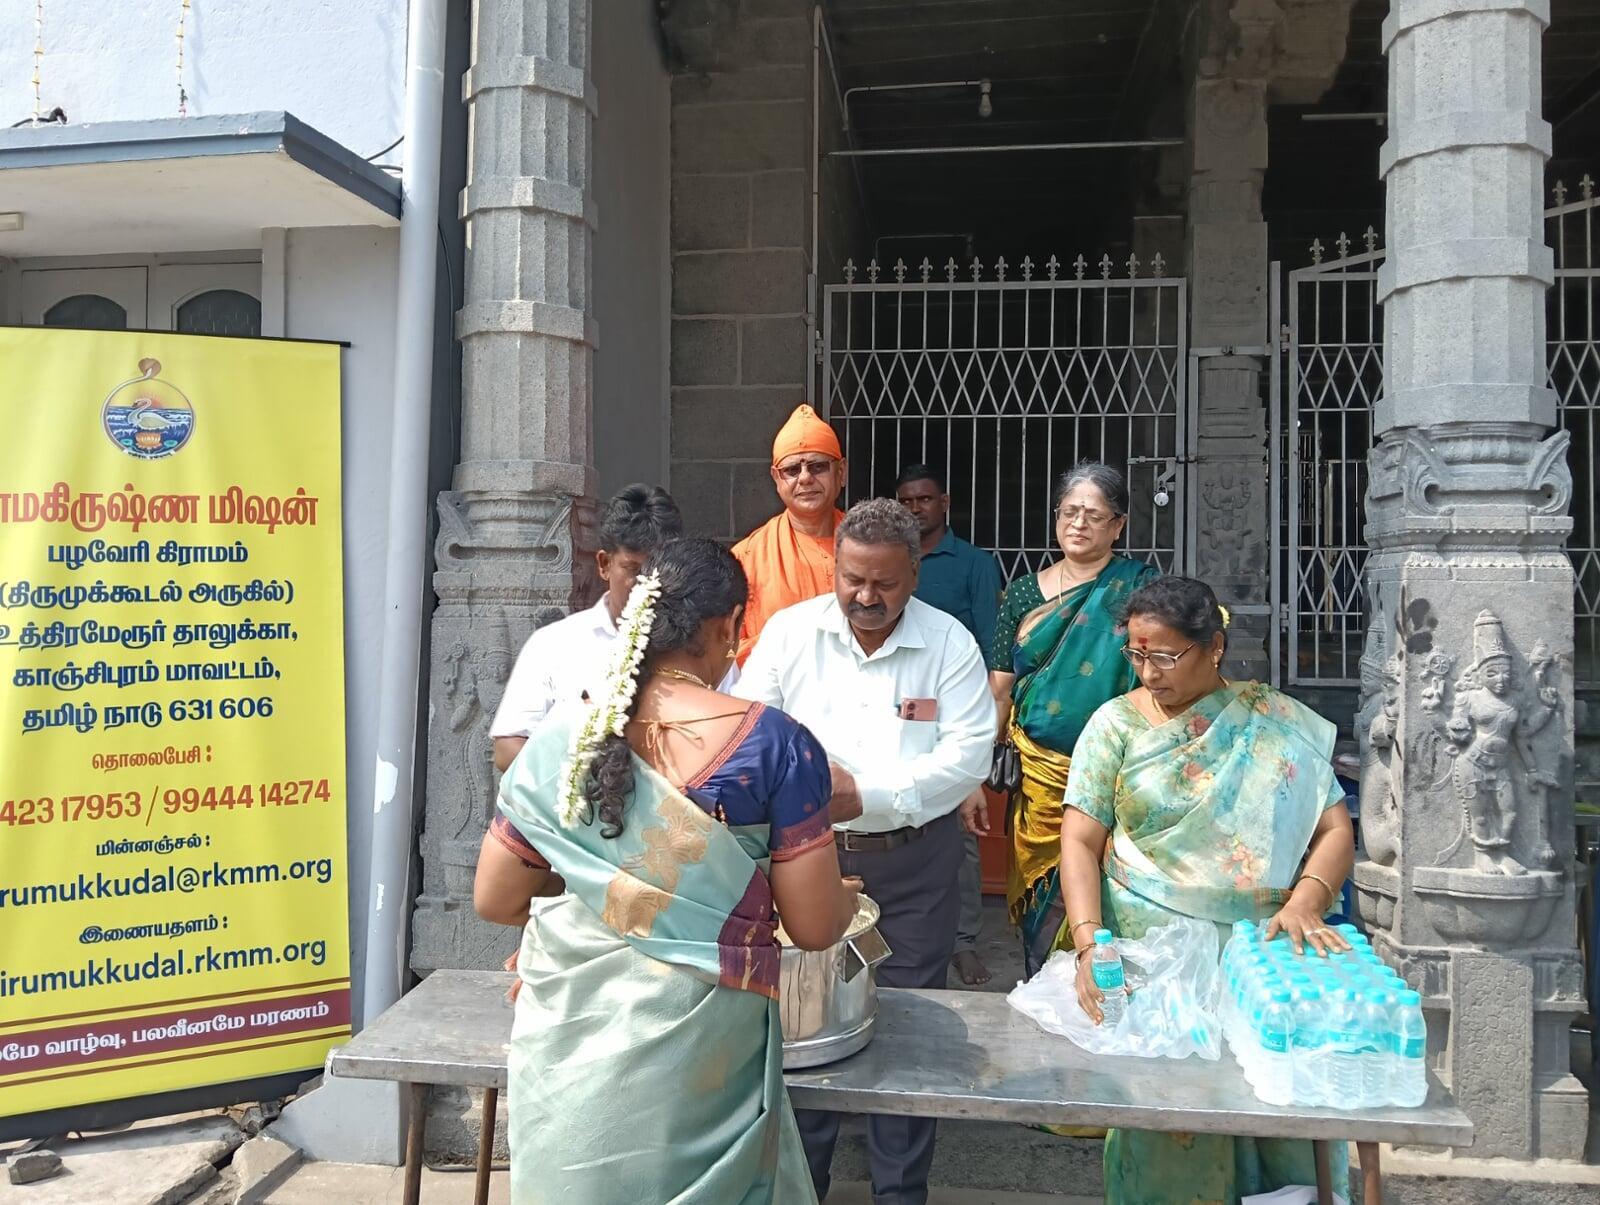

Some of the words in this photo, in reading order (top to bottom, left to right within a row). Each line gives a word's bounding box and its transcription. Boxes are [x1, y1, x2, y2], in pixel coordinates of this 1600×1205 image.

[209, 486, 318, 534] மிஷன்
[48, 540, 149, 570] பழவேரி
[156, 541, 248, 566] கிராமம்
[0, 580, 182, 610] (திருமுக்கூடல்
[189, 580, 293, 605] அருகில்)
[173, 618, 298, 649] தாலுக்கா,
[13, 659, 159, 691] காஞ்சிபுரம்
[166, 656, 281, 681] மாவட்டம்,
[22, 702, 97, 735] தமிழ்
[104, 702, 162, 731] நாடு
[169, 699, 212, 721] 631
[219, 697, 273, 719] 606
[0, 939, 326, 997] irumukkudal.rkmm.org
[0, 1042, 40, 1061] மே
[45, 1032, 127, 1055] வாழ்வு,
[132, 1014, 246, 1043] பலவீனமே
[250, 1001, 330, 1026] மரணம்
